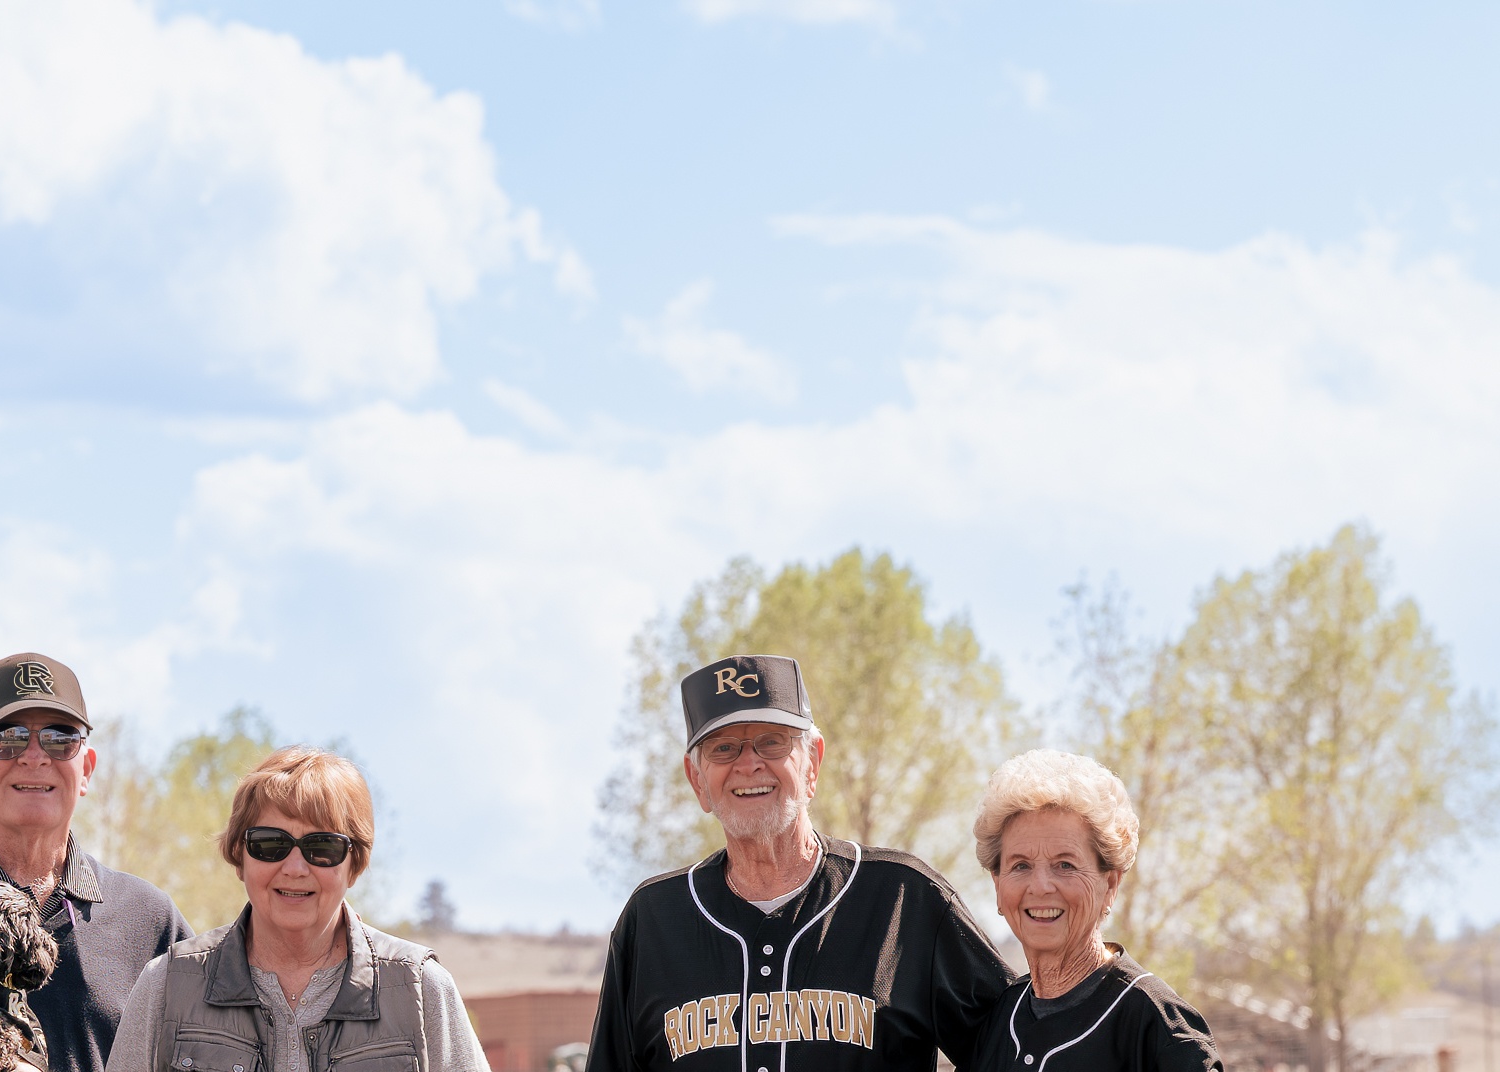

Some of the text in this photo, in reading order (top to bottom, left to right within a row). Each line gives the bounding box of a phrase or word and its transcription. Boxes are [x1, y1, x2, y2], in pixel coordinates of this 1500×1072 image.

[714, 667, 760, 698] RC
[664, 989, 876, 1062] ROCK CANYON
